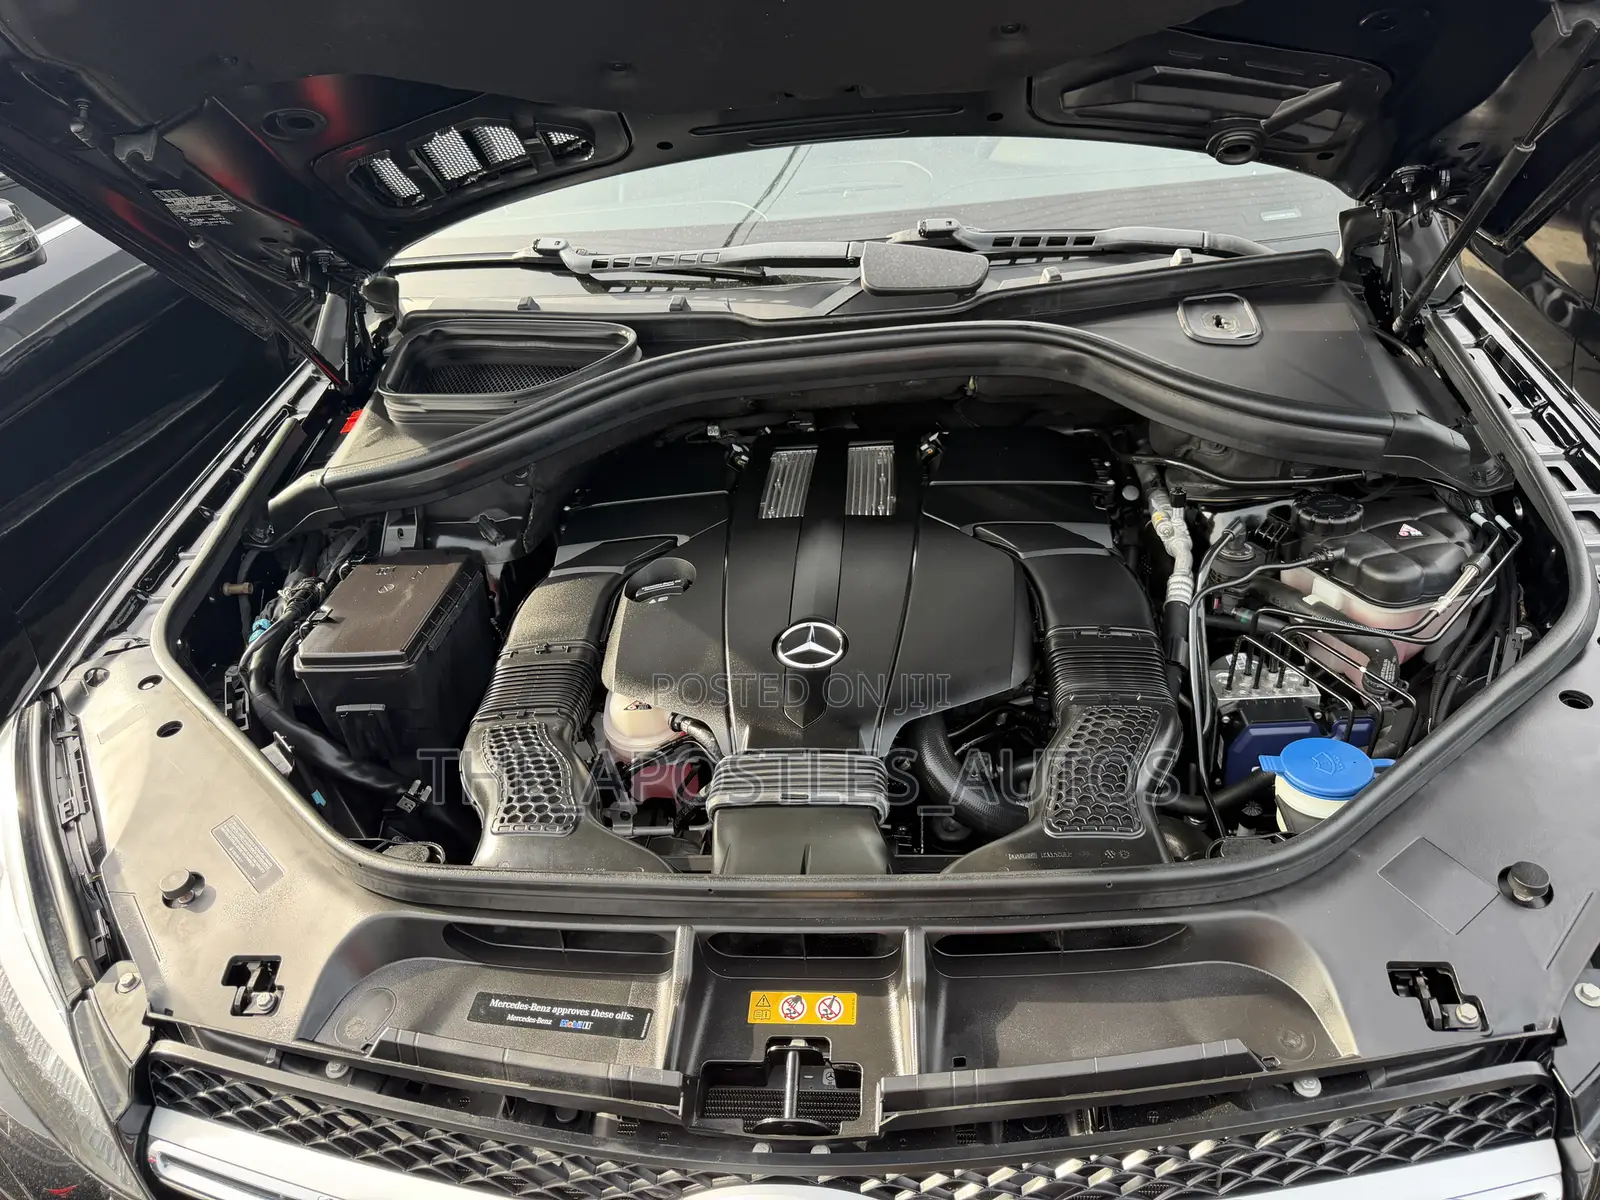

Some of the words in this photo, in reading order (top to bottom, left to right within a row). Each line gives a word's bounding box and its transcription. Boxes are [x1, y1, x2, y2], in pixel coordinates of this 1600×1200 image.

[489, 999, 551, 1013] Mercedes-Benz
[552, 1006, 590, 1017] approves
[591, 1009, 614, 1018] these
[615, 1011, 634, 1021] oils:
[506, 1014, 553, 1025] Mercedes-Benz
